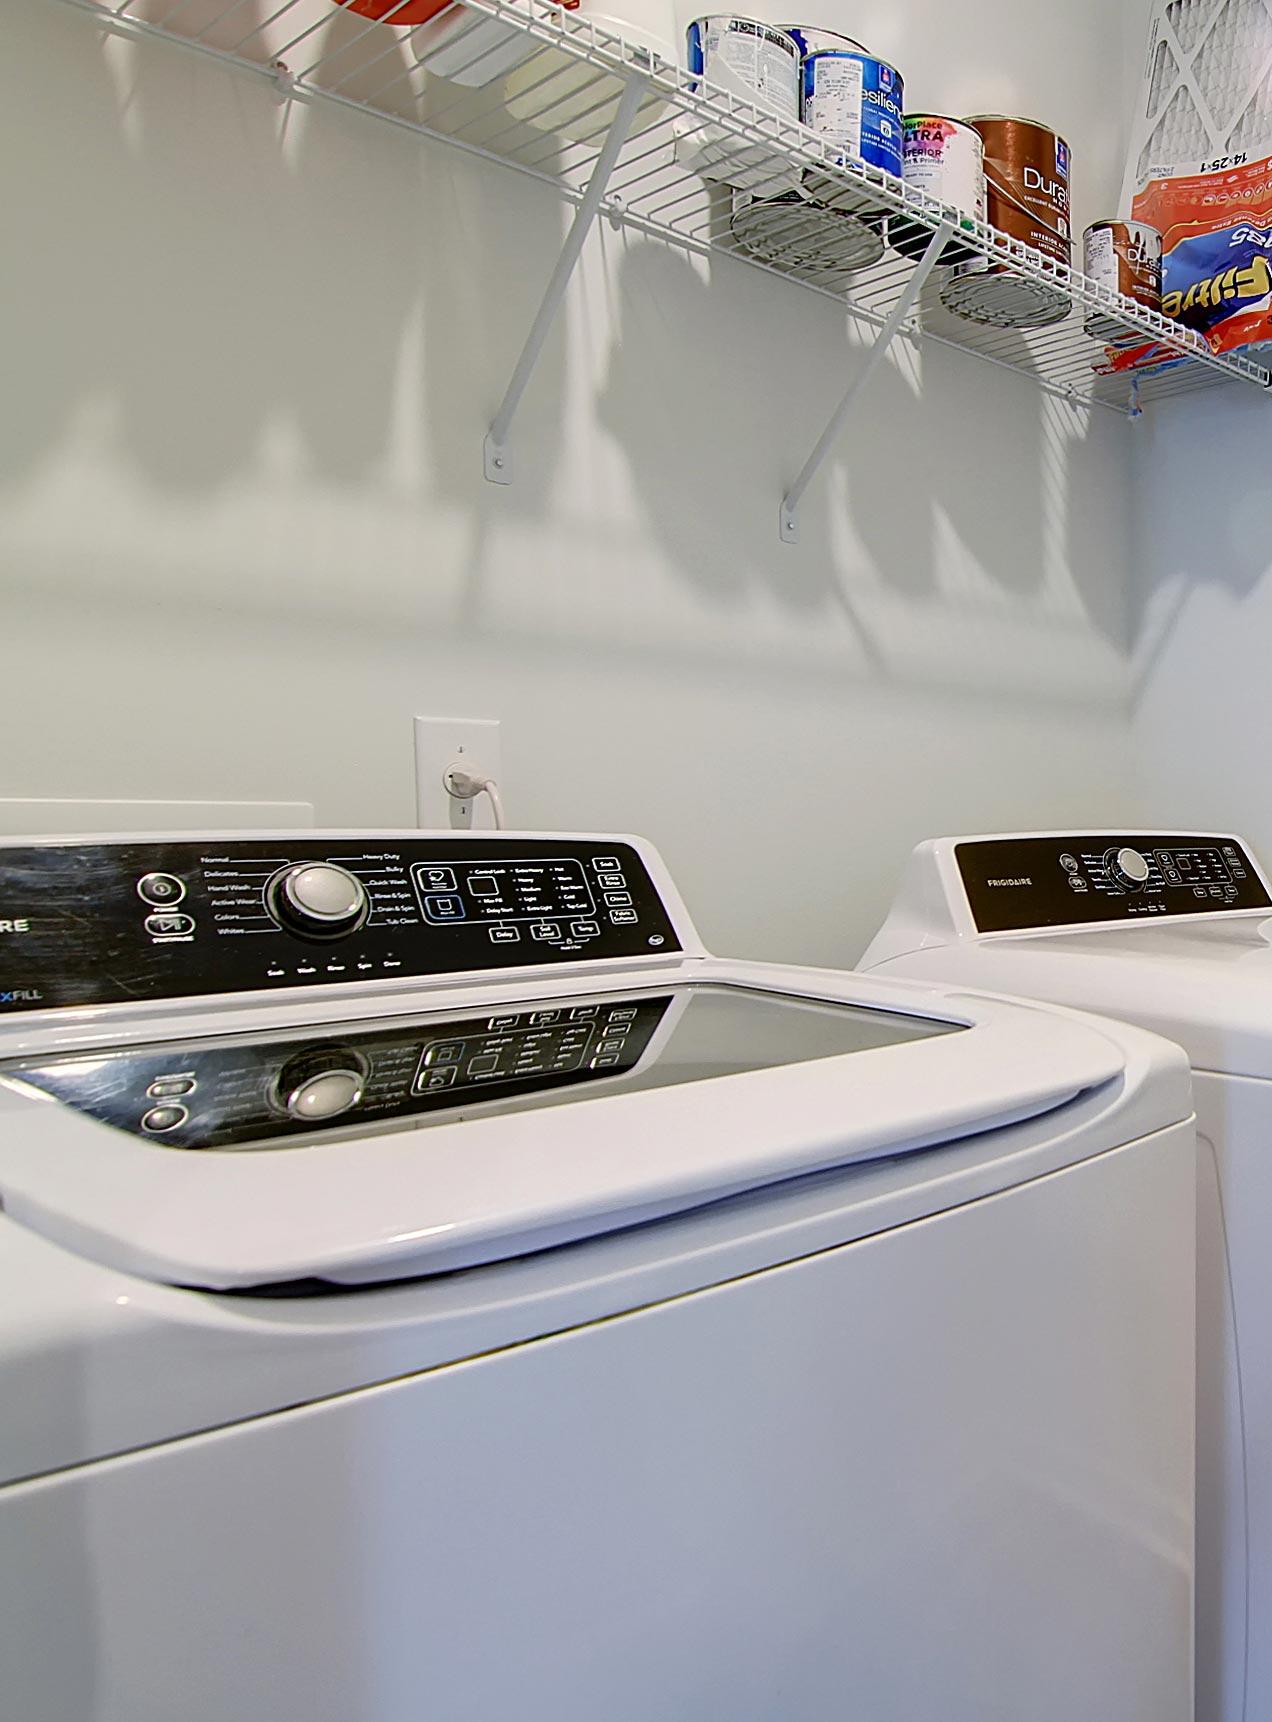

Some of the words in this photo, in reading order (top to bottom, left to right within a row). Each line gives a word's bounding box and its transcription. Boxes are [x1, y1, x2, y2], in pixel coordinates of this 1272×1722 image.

[904, 121, 943, 130] lorPlace
[904, 130, 944, 143] LTRA
[903, 148, 942, 158] TERIOR
[1023, 167, 1069, 204] Dura
[1161, 255, 1270, 318] Filtre
[987, 878, 1033, 887] FRIGIDAIRE
